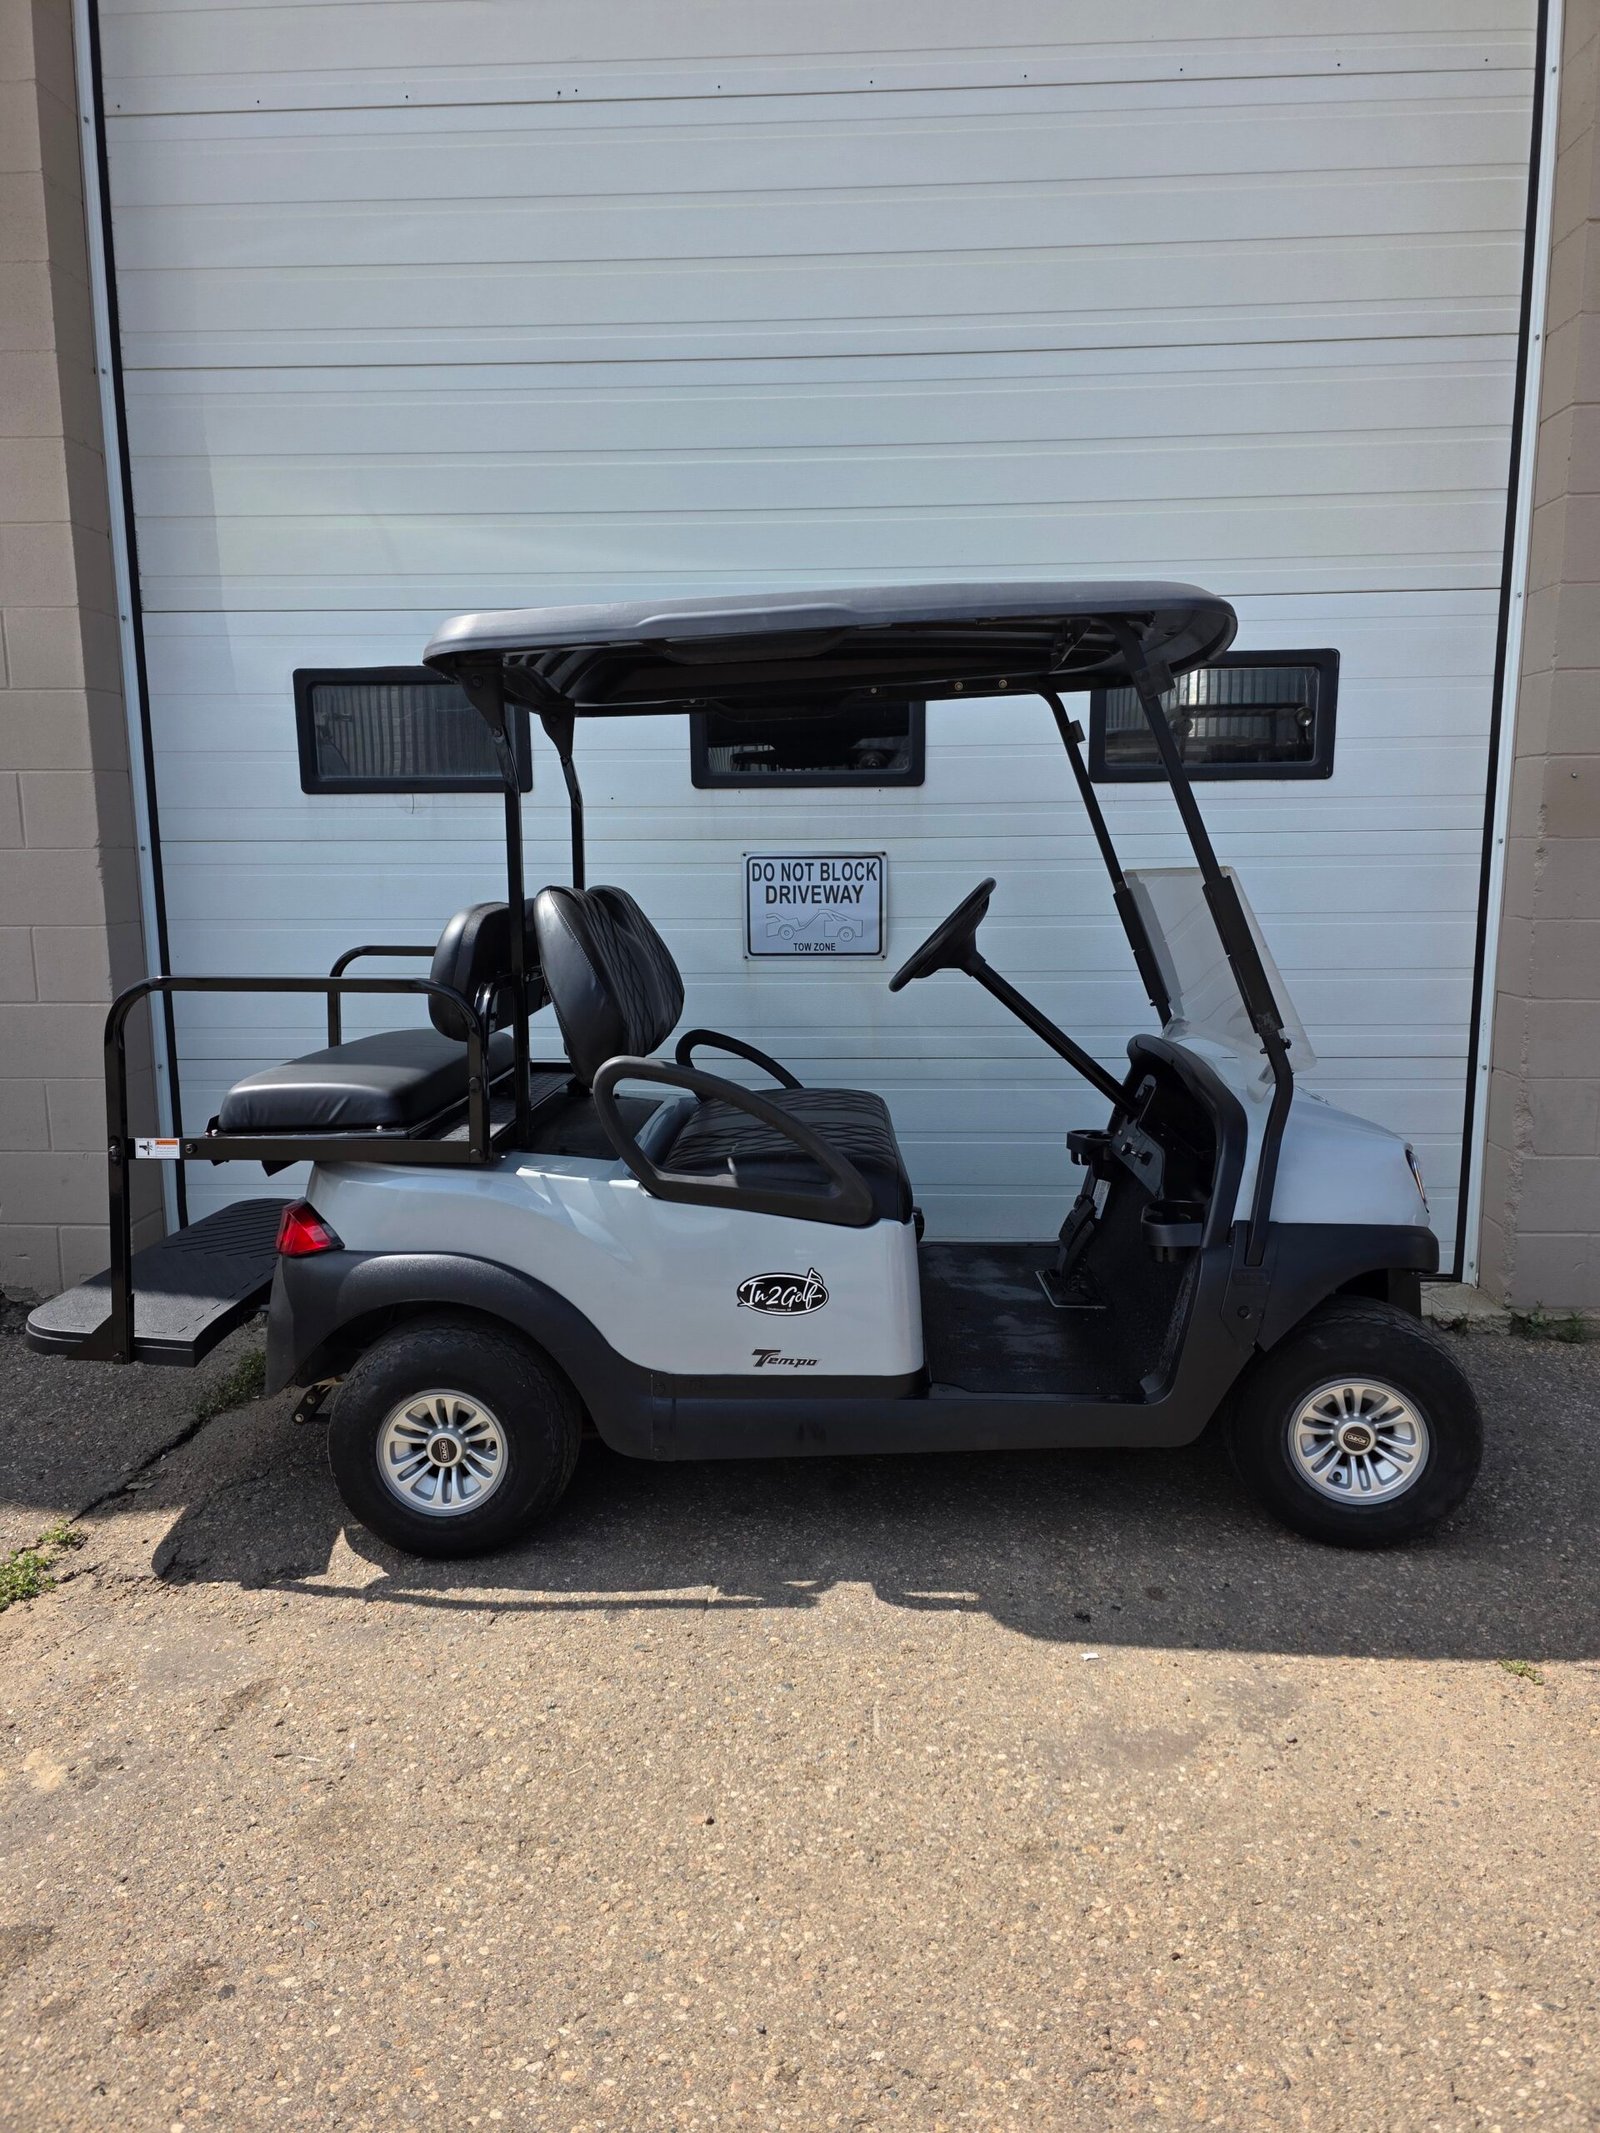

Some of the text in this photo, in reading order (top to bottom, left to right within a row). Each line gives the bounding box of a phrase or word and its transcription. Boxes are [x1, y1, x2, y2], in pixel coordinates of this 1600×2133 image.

[752, 861, 878, 882] DO NOT BLOCK
[765, 884, 864, 904] DRIVEWAY
[793, 942, 836, 952] TOW ZONE
[752, 1349, 818, 1367] Tempo
